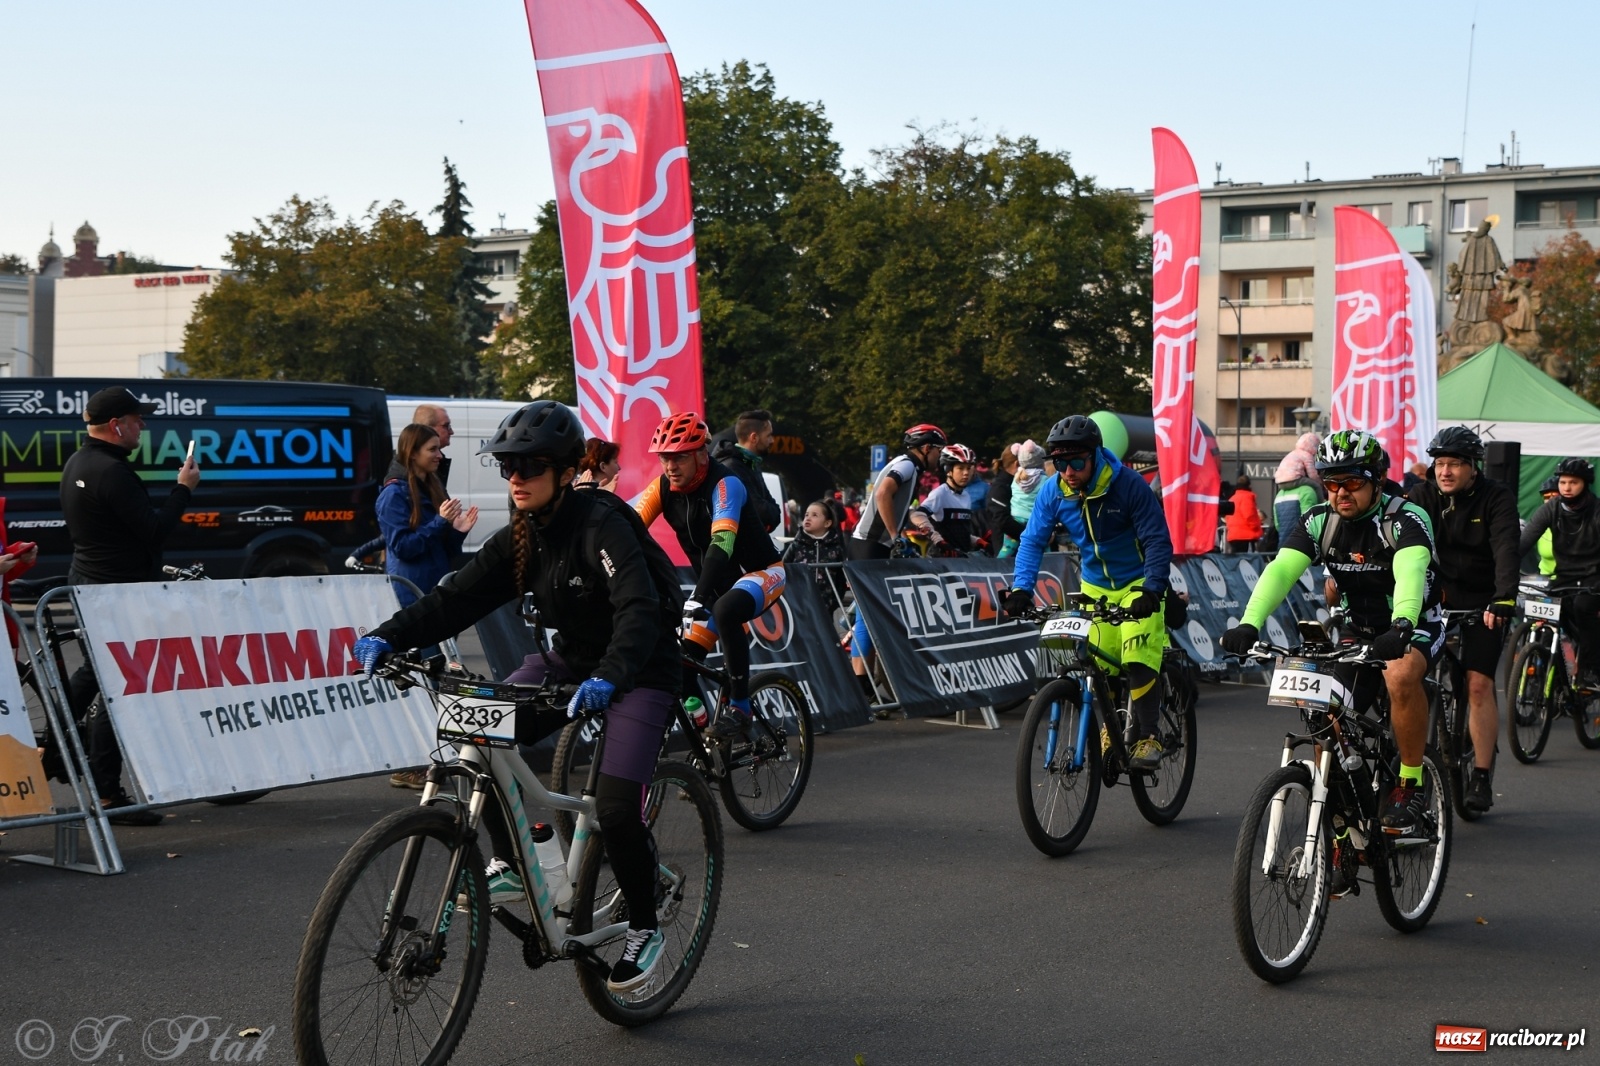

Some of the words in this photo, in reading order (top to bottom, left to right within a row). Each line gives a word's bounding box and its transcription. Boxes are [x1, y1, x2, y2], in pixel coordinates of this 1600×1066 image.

[874, 448, 884, 468] P
[181, 512, 220, 523] CST
[304, 510, 355, 521] MAXXIS
[1532, 605, 1555, 616] 3175
[1049, 621, 1081, 631] 3240
[106, 626, 361, 696] YAKIMA
[927, 652, 1028, 696] USZCZELNIAMY
[1279, 675, 1321, 694] 2154
[200, 700, 263, 738] TAKE
[261, 691, 326, 731] MORE
[452, 704, 503, 729] 3239
